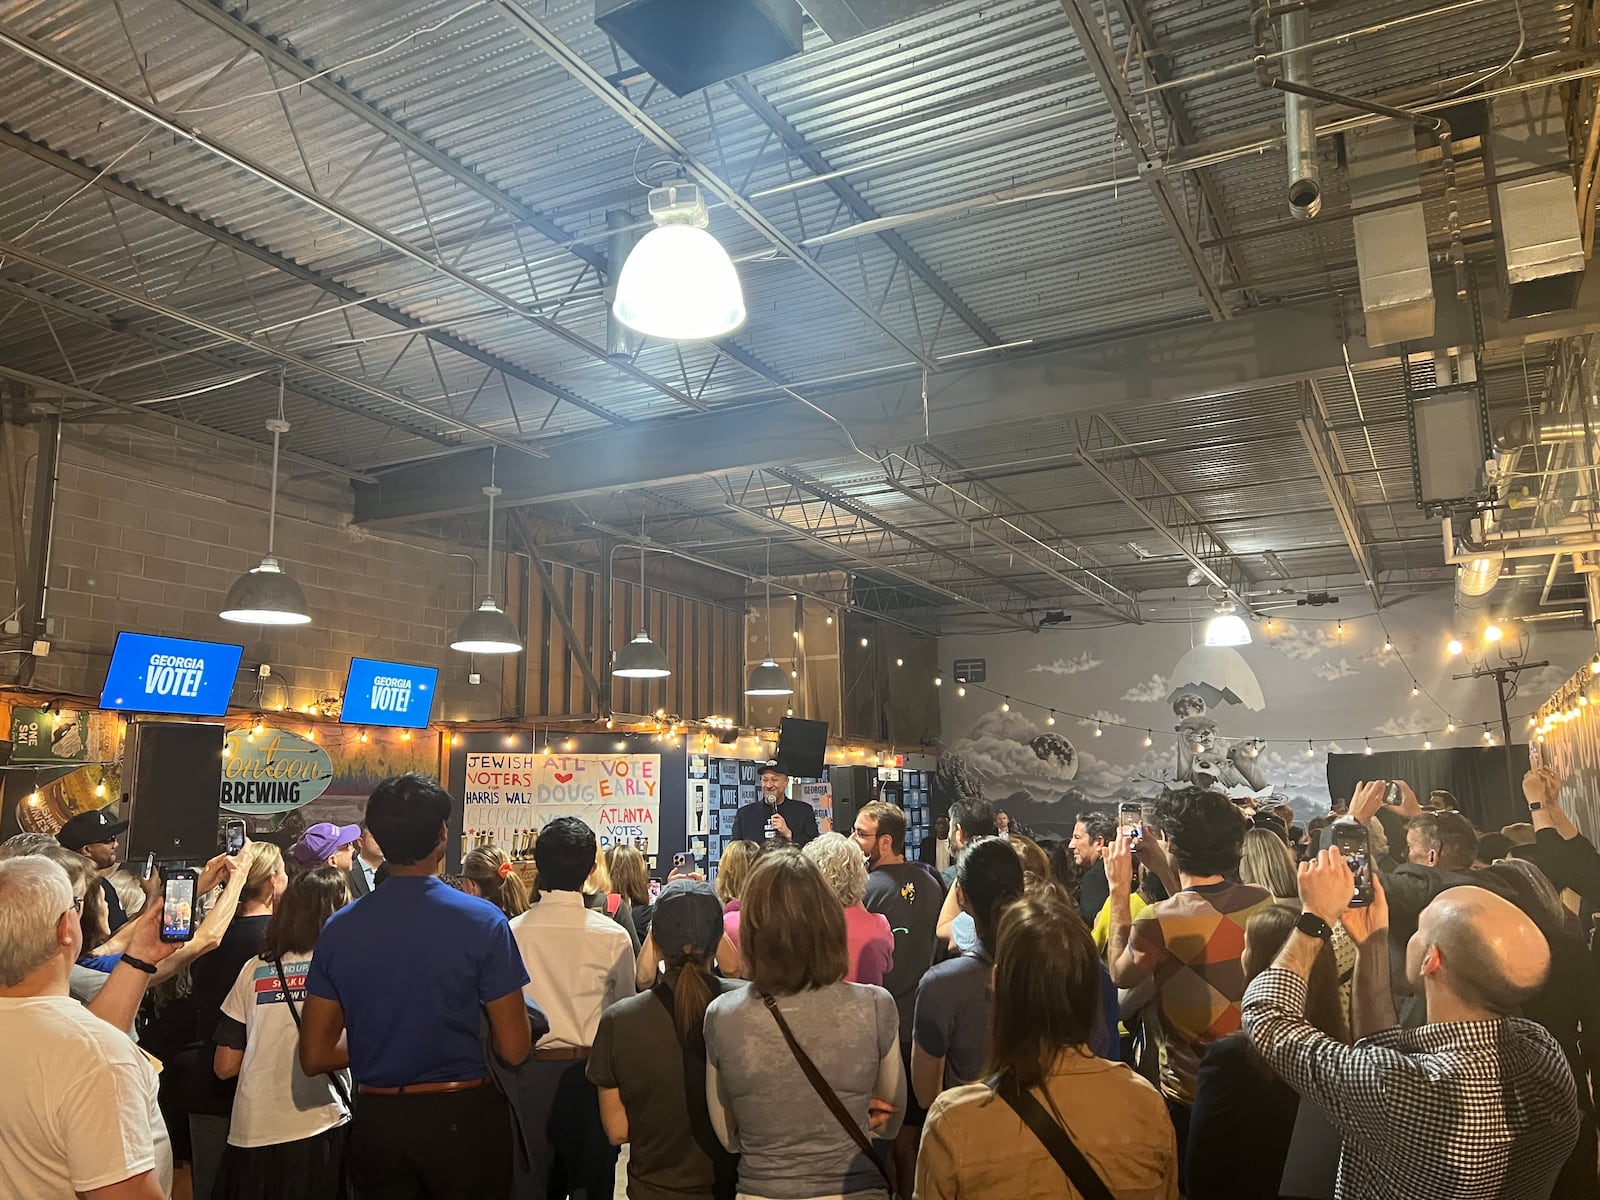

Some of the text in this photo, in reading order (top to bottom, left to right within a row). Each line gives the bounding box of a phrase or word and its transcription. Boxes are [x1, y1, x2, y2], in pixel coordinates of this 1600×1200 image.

[150, 654, 205, 670] GEORGIA
[145, 665, 204, 698] VOTE!
[373, 675, 412, 689] GEORGIA
[370, 685, 411, 712] VOTE!
[18, 724, 29, 744] SKI
[28, 722, 38, 747] ONE
[468, 756, 533, 769] JEWISH
[543, 757, 585, 771] ATL
[600, 760, 652, 778] VOTE
[467, 772, 532, 788] VOTERS
[599, 778, 656, 797] EARLY
[221, 781, 300, 804] BREWING
[466, 791, 532, 805] HARRIS WALZ
[537, 784, 595, 803] DOUG
[722, 789, 737, 805] VOTE
[803, 785, 828, 795] GEORGIA
[599, 808, 653, 824] ATLANTA
[606, 825, 642, 836] VOTES
[270, 966, 295, 975] SND
[275, 990, 300, 1001] SHW
